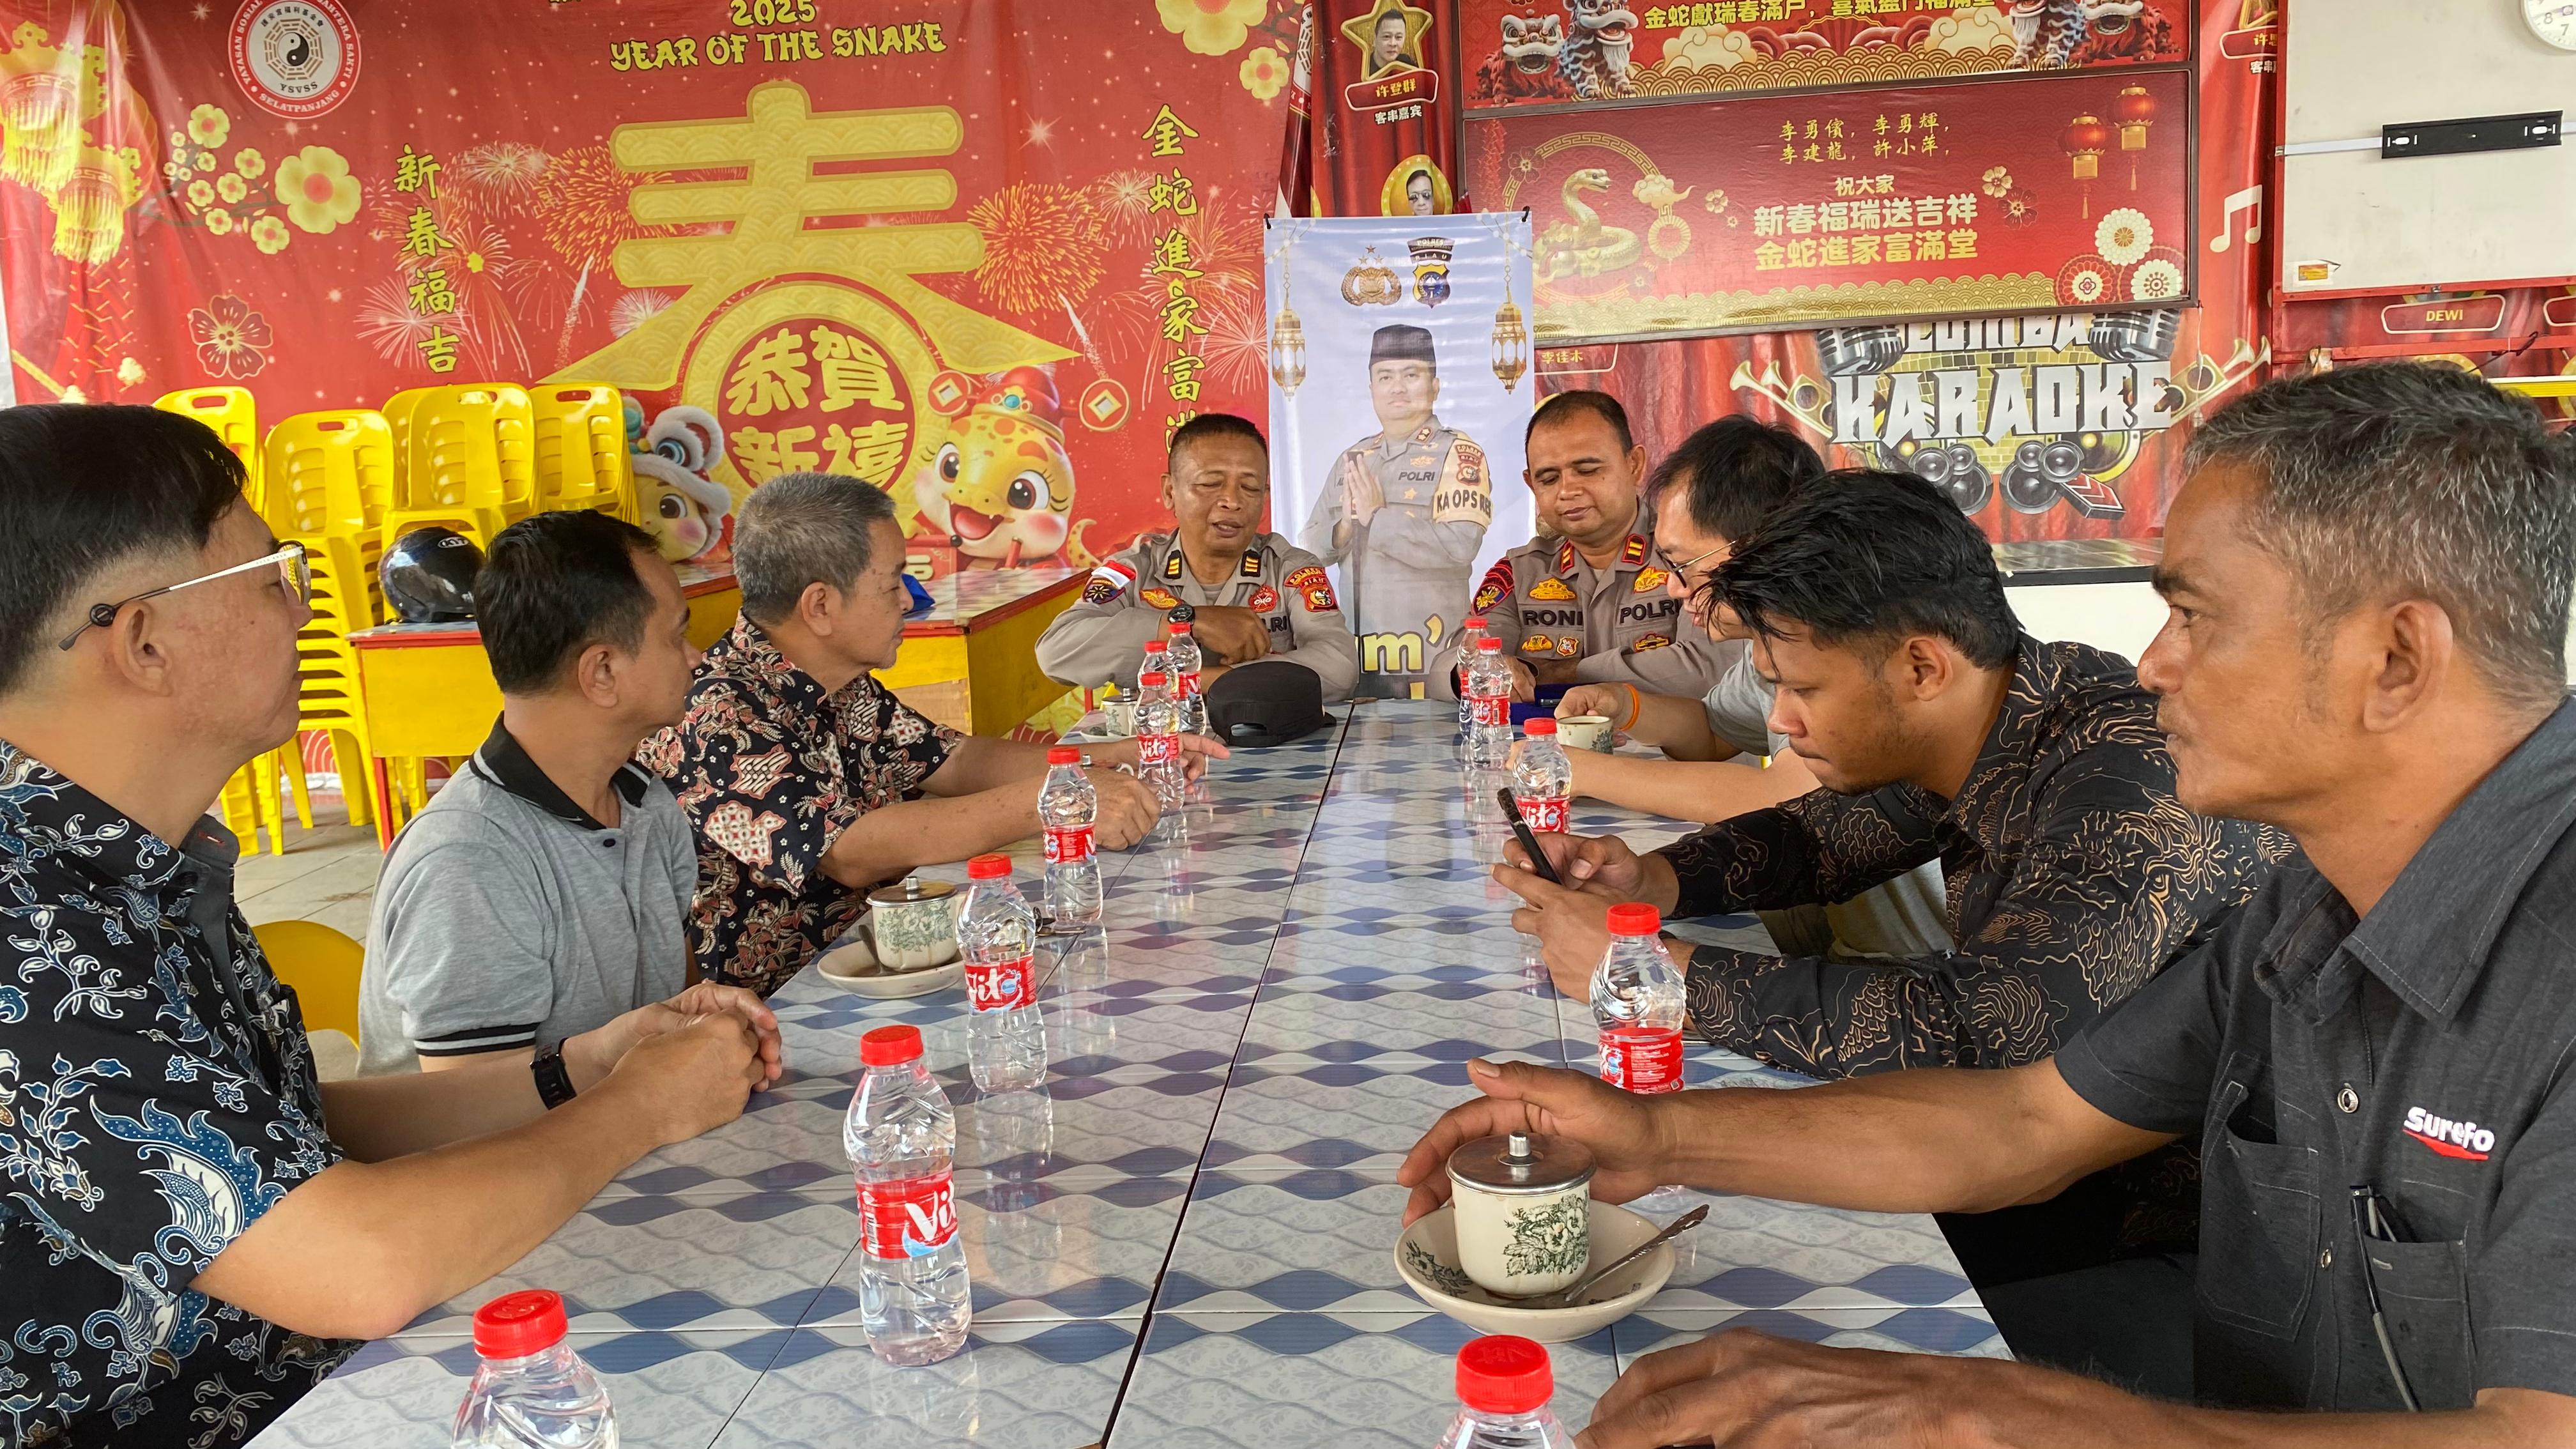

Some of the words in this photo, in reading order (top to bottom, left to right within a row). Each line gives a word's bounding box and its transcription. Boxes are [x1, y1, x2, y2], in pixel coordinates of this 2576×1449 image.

[730, 0, 817, 27] 2025
[2561, 24, 2570, 36] 7
[610, 37, 700, 72] YEAR
[705, 33, 749, 66] OF
[756, 30, 824, 62] THE
[831, 22, 947, 58] SNAKE
[234, 36, 252, 84] YAYASAN
[342, 43, 355, 79] SAKTI
[280, 81, 318, 93] YSVSS
[1376, 78, 1416, 98] 许登群
[259, 89, 341, 112] SELATPANJANG
[1835, 174, 1895, 197] 祝大家
[1753, 192, 1978, 236] 新春福瑞送吉祥
[1754, 228, 1979, 271] 金蛇進家富滿堂
[2425, 309, 2464, 323] DEWI
[726, 325, 905, 417] 恭賀
[1830, 360, 2172, 449] KARAOKE
[1398, 471, 1436, 482] POLRI
[1437, 491, 1450, 514] KA
[1452, 489, 1478, 509] OPS
[1522, 610, 1583, 626] RONI
[1138, 738, 1160, 760] Vit
[2404, 1106, 2496, 1152] Surefo
